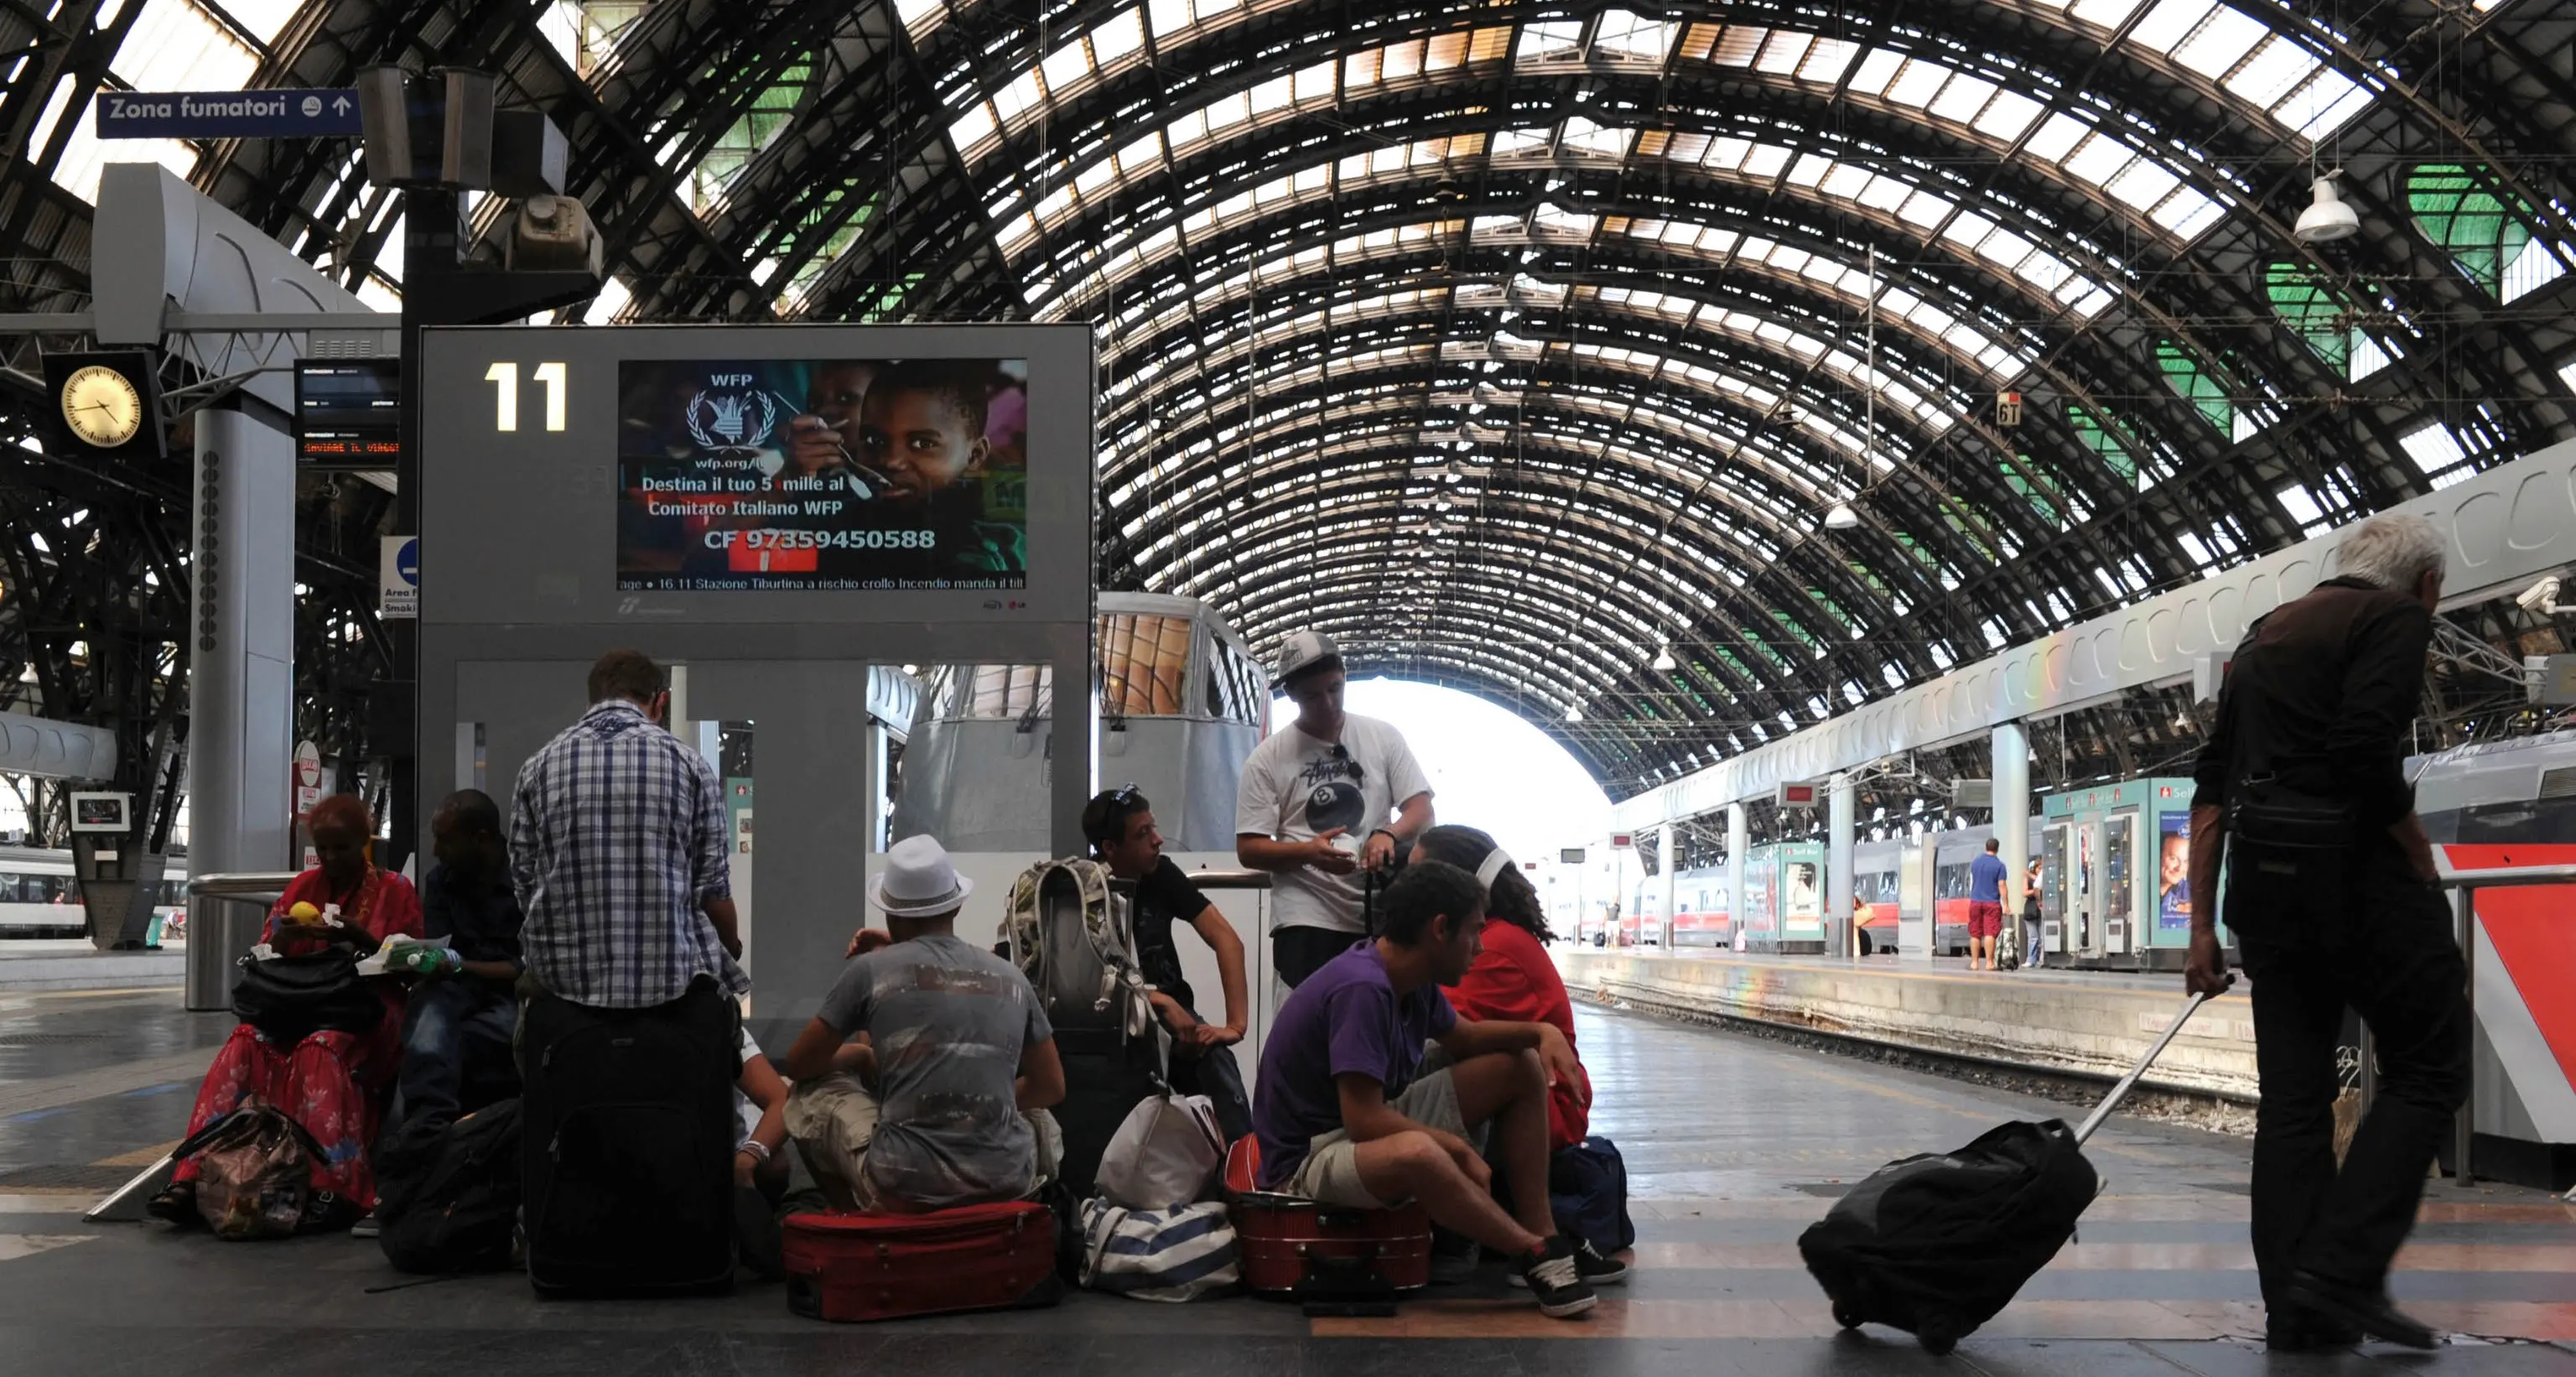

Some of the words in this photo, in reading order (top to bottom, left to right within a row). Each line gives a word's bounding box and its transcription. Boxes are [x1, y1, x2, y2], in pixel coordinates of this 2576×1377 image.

[110, 99, 171, 117] Zona
[180, 95, 285, 117] fumatori
[711, 374, 753, 387] WFP
[485, 362, 566, 432] 11
[1999, 403, 2019, 423] 6T
[642, 477, 707, 491] Destina
[713, 476, 721, 491] il
[728, 478, 756, 491] tuo
[761, 476, 772, 491] 5
[782, 475, 823, 491] mille
[828, 476, 844, 491] al
[649, 501, 727, 517] Comitato
[733, 501, 798, 516] Italiano
[804, 501, 843, 515] WFP
[704, 531, 738, 549] CF
[746, 531, 936, 549] 97359450588
[385, 588, 409, 596] Area
[618, 579, 642, 591] age
[695, 579, 748, 590] Stazione
[751, 578, 803, 590] Tiburtina
[807, 580, 815, 590] a
[818, 578, 859, 590] rischio
[862, 578, 896, 590] crollo
[899, 578, 951, 590] Incendio
[954, 578, 996, 590] manda
[1000, 577, 1006, 590] il
[1010, 577, 1024, 590] tilt
[1317, 788, 1330, 803] 8
